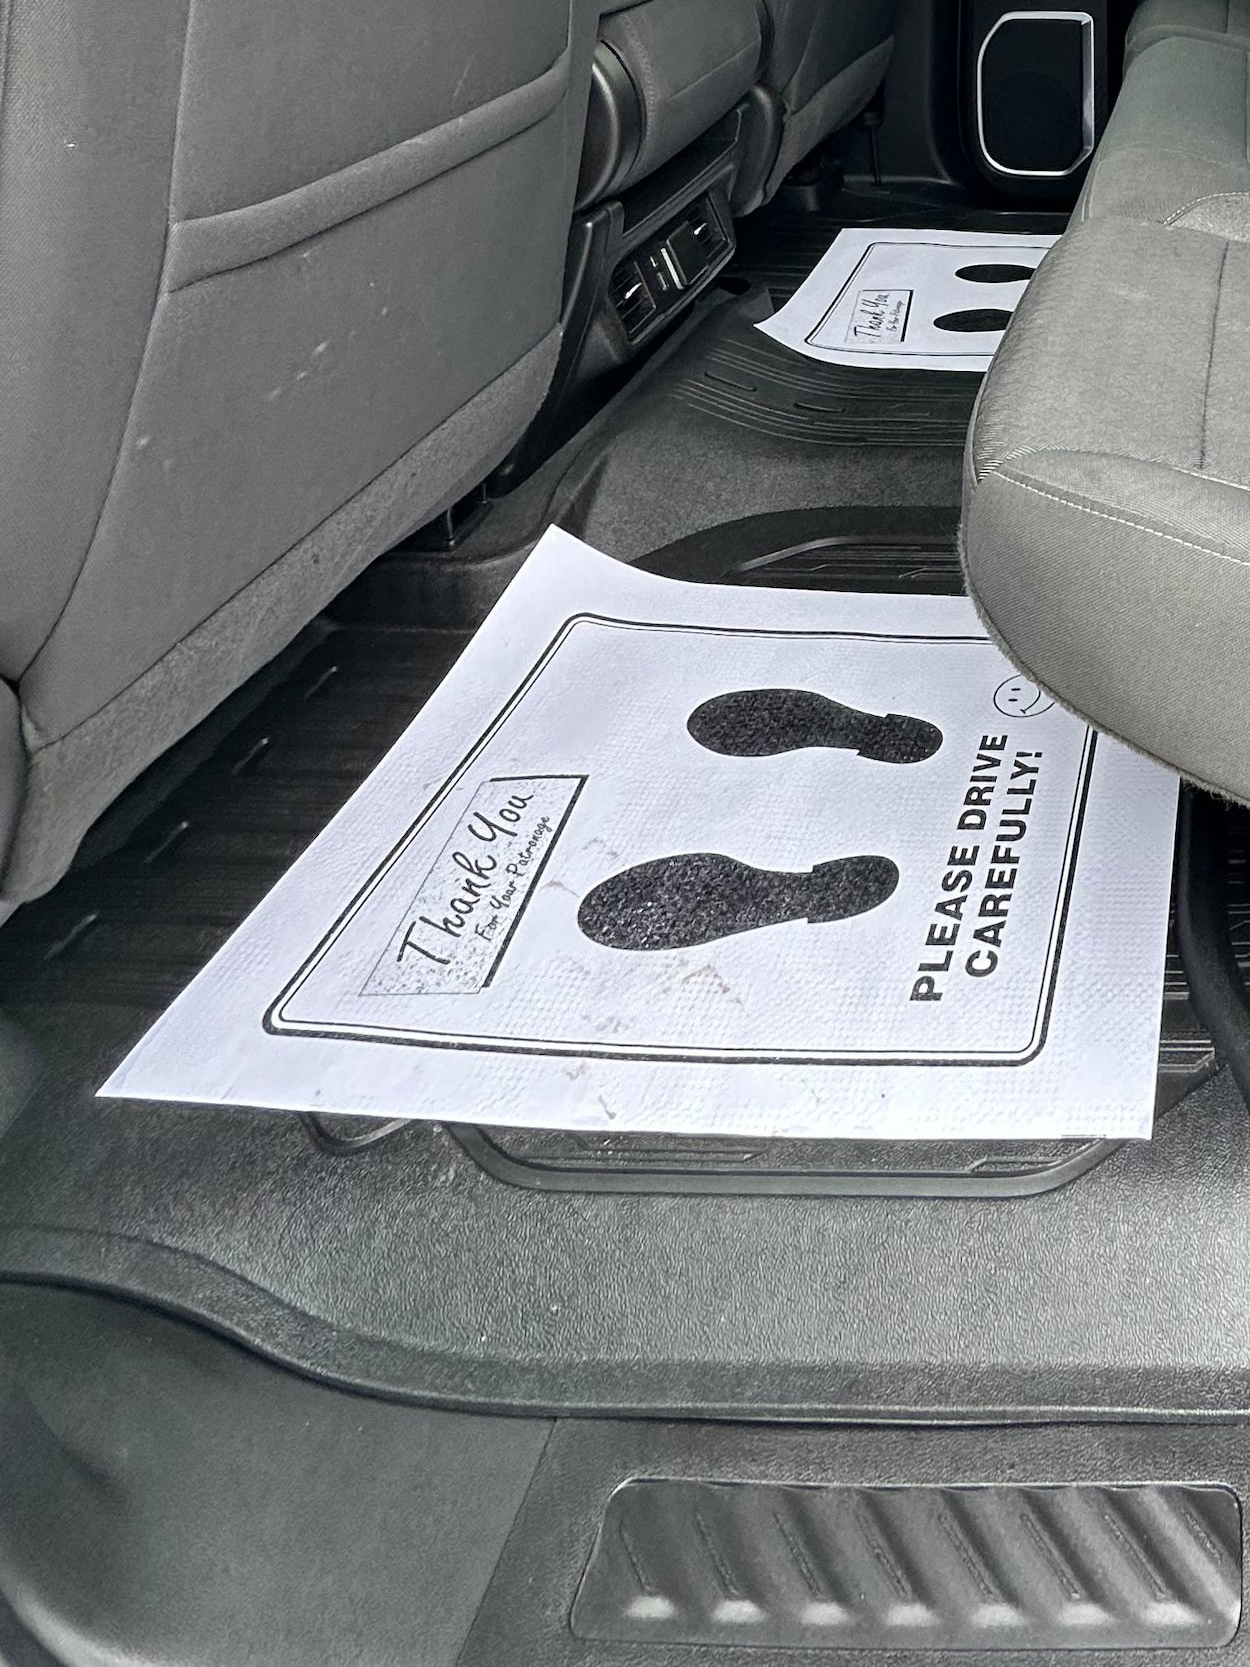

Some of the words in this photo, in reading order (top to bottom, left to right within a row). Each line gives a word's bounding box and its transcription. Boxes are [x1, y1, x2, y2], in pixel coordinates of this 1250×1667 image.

[397, 851, 497, 966] Thank
[467, 793, 535, 843] You
[474, 914, 499, 941] For
[489, 880, 518, 910] Your
[505, 815, 553, 877] Patronage
[909, 845, 980, 1002] PLEASE
[957, 734, 1008, 831] DRIVE
[964, 751, 1043, 977] CAREFULLY!
